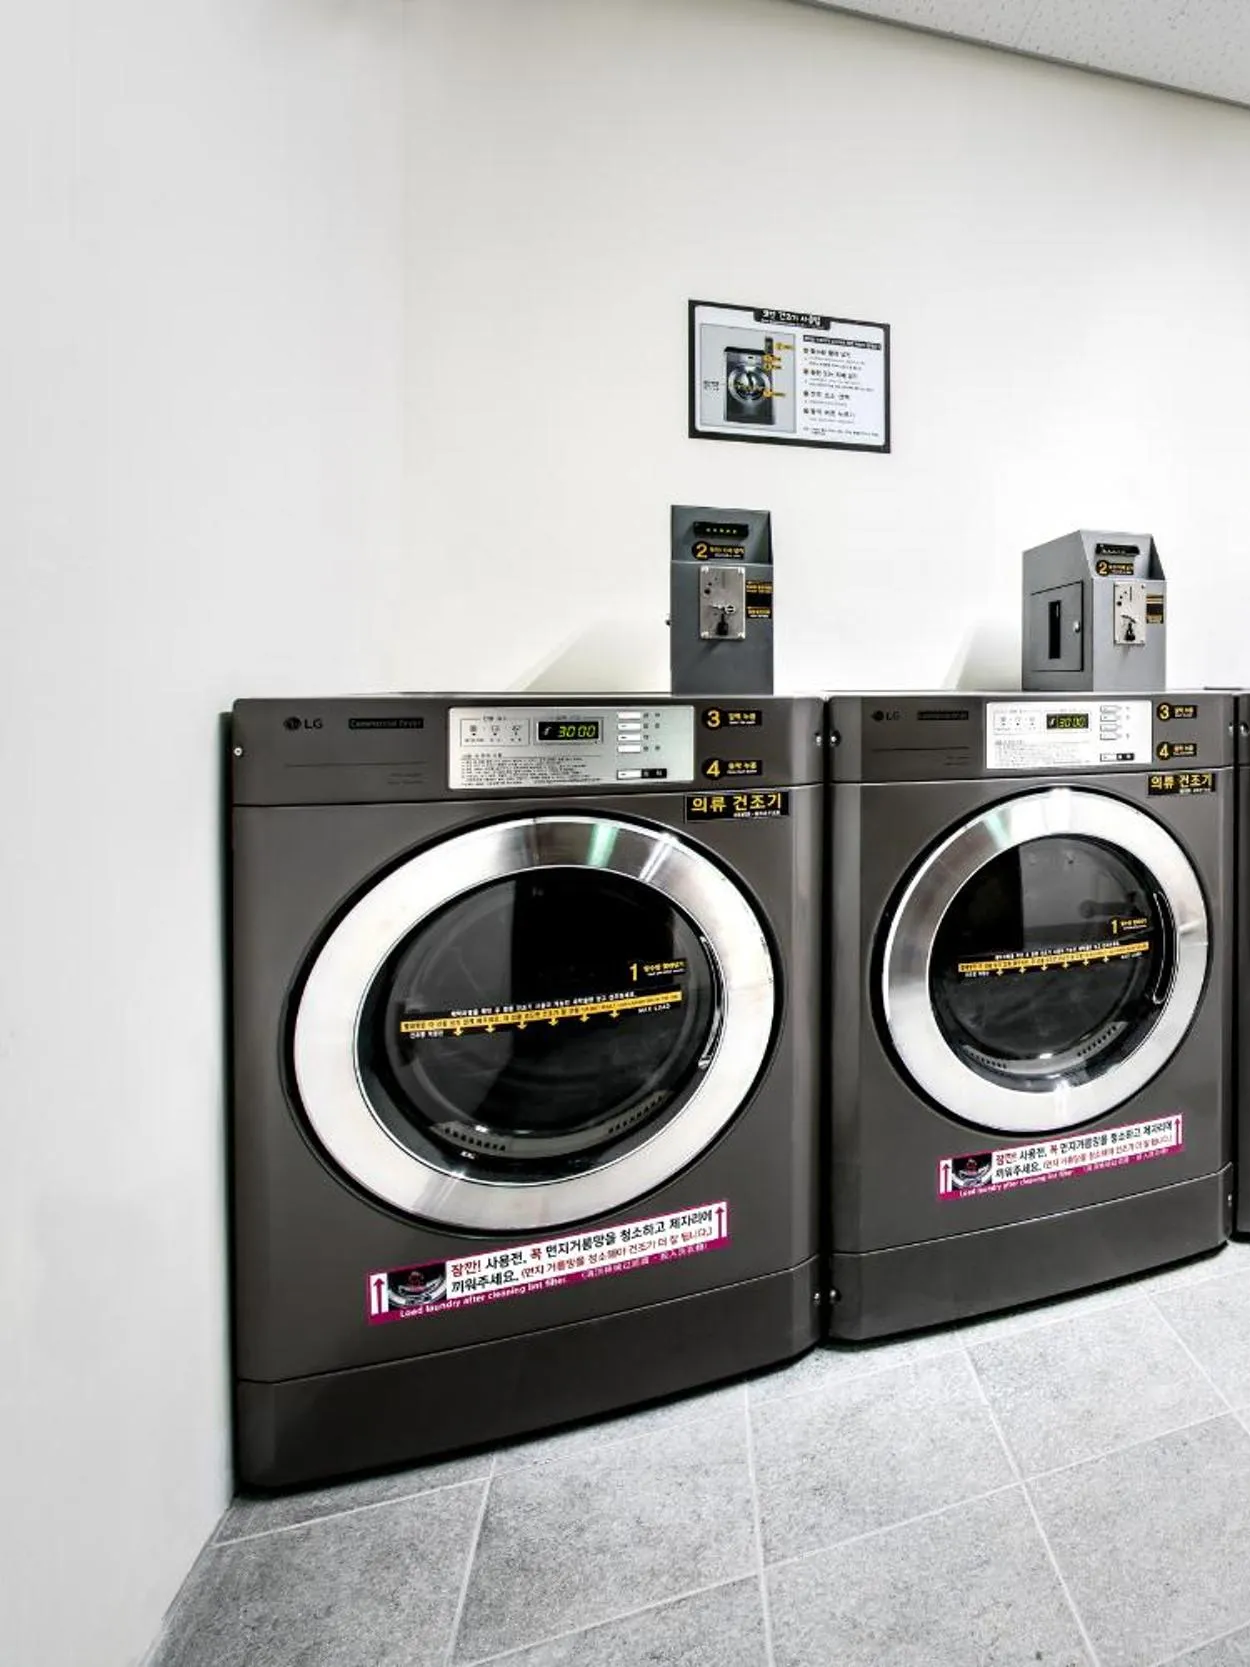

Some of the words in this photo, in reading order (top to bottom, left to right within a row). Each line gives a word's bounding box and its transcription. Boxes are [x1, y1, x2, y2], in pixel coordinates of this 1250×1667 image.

[696, 543, 708, 559] 2
[1098, 562, 1108, 575] 2
[707, 710, 721, 727] 3
[1159, 704, 1170, 720] 3
[304, 718, 324, 730] LG
[1159, 744, 1169, 758] 4
[706, 760, 721, 777] 4
[1150, 775, 1175, 790] 의류
[1179, 773, 1213, 789] 건조기
[691, 796, 727, 813] 의류
[732, 792, 781, 812] 건조기
[1111, 919, 1118, 935] 1
[629, 963, 638, 982] 1
[653, 1003, 671, 1012] LOAD
[960, 1188, 976, 1197] Load
[1020, 1175, 1047, 1186] cleaning
[450, 1260, 482, 1278] 잠깐!
[530, 1247, 543, 1260] 꼭
[545, 1232, 617, 1258] 먼지거름망을
[619, 1221, 666, 1243] 청소하고
[669, 1209, 713, 1230] 제자리에
[450, 1269, 520, 1294] 끼워주세요.
[521, 1264, 545, 1279] (먼지
[546, 1254, 585, 1272] 거름망을
[658, 1236, 668, 1247] 더
[669, 1233, 679, 1244] 잘
[399, 1305, 424, 1318] Load
[425, 1299, 461, 1315] laundry
[463, 1294, 486, 1306] after
[487, 1286, 527, 1301] cleaning
